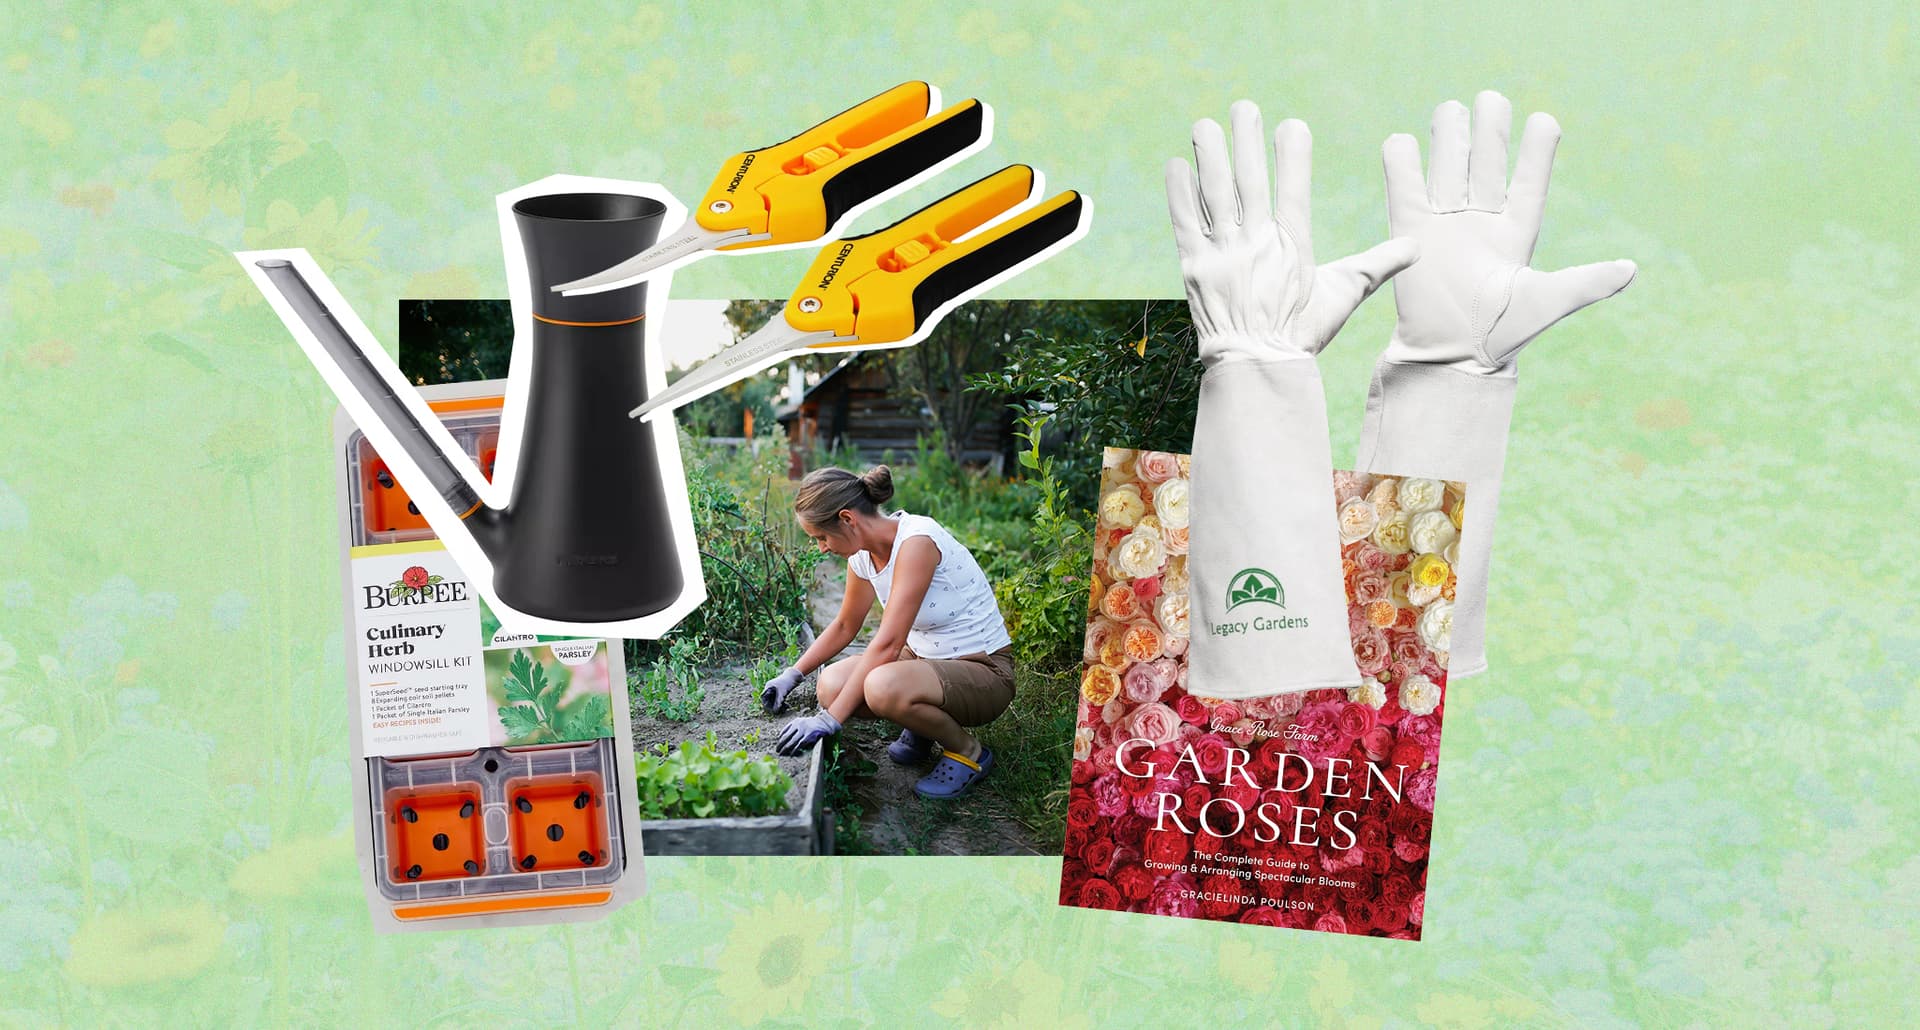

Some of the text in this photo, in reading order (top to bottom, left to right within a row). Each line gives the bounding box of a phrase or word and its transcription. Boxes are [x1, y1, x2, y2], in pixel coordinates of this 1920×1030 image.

[727, 154, 755, 193] CENTURION
[818, 243, 854, 289] CENTURION
[366, 623, 446, 641] Culinary
[1210, 615, 1309, 637] Legacy Gardens
[368, 641, 415, 658] Herb
[494, 634, 534, 643] CILANTRO
[368, 656, 472, 674] WINDOWSILL KIT
[558, 650, 592, 659] PARSLEY
[430, 684, 454, 692] starting
[1210, 717, 1319, 742] Grace Rose Farm
[1115, 738, 1409, 804] GARDEN
[1151, 792, 1358, 850] ROSES
[1193, 850, 1310, 871] The Complete Guide to
[1144, 859, 1356, 889] Growing & Arranging Spectacular Blooms
[1180, 889, 1315, 911] GRACIELINDA POULSON
